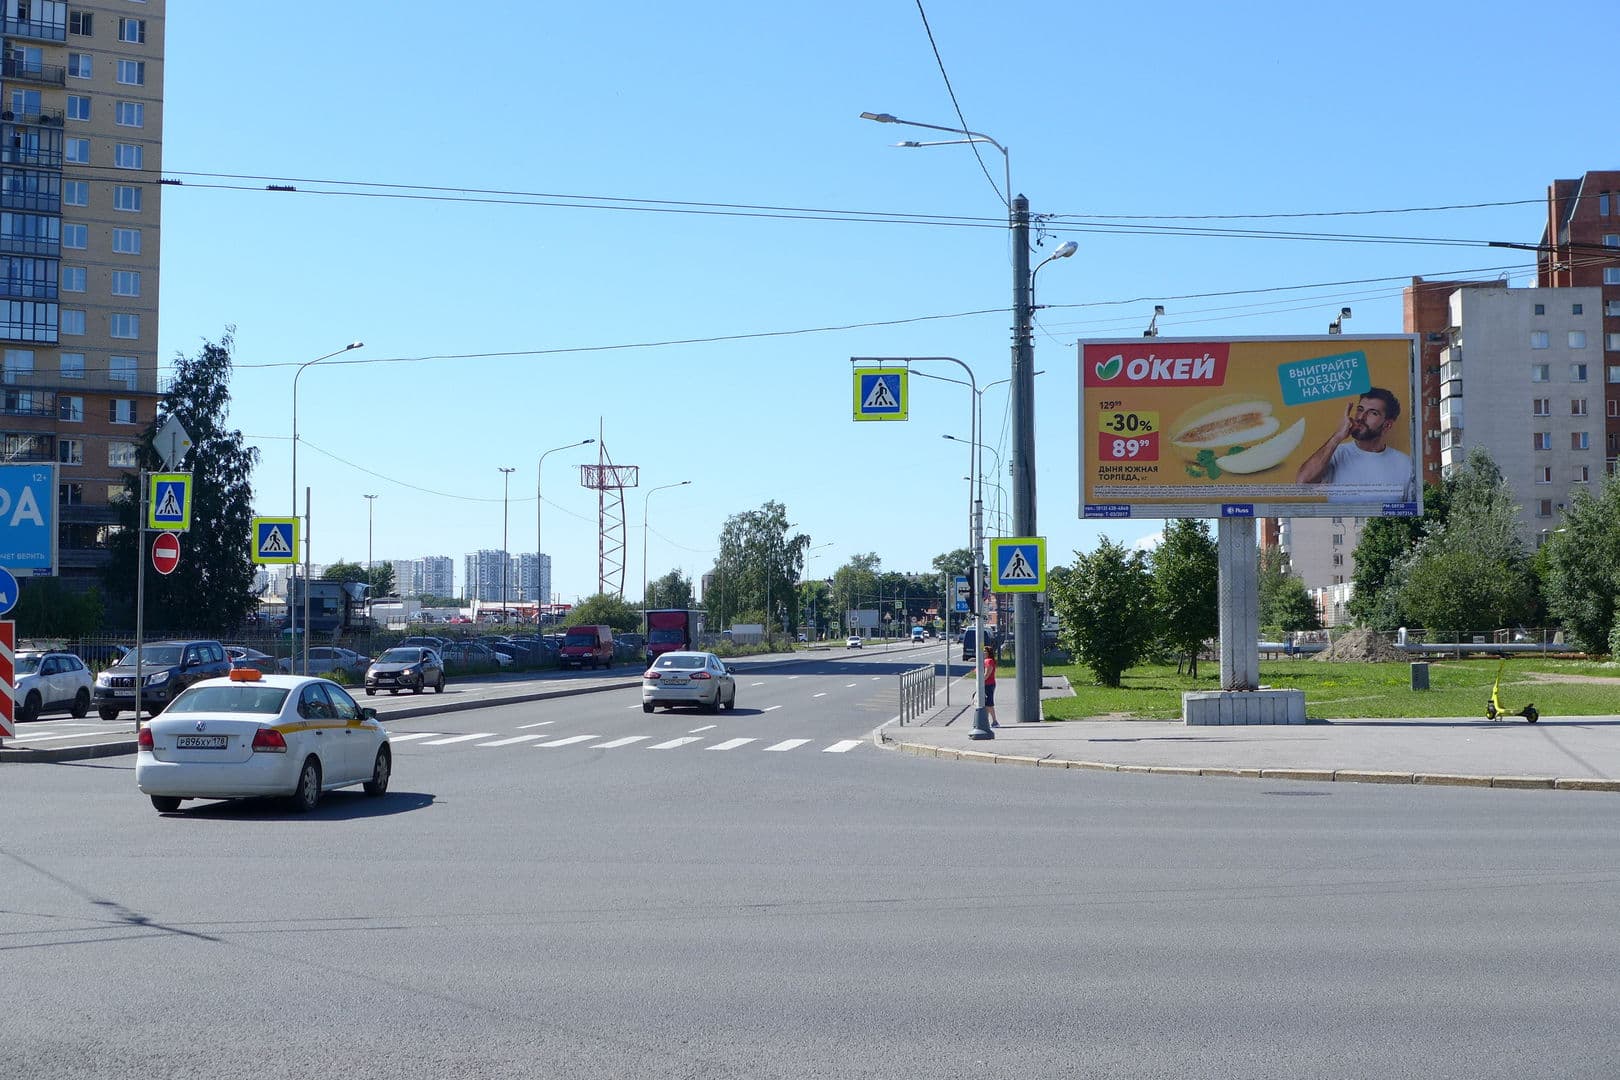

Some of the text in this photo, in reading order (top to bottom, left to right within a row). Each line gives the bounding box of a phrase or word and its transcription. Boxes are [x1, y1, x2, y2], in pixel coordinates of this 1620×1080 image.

[1127, 353, 1215, 380] О'КЕЙ
[1289, 359, 1358, 378] ВЫИГРАЙТЕ
[1297, 370, 1353, 387] ПОЕЗДКУ
[1302, 381, 1352, 397] НА КУБУ
[1106, 414, 1152, 431] -30%
[33, 473, 47, 482] 12+
[1099, 465, 1123, 473] ДЫНЯ
